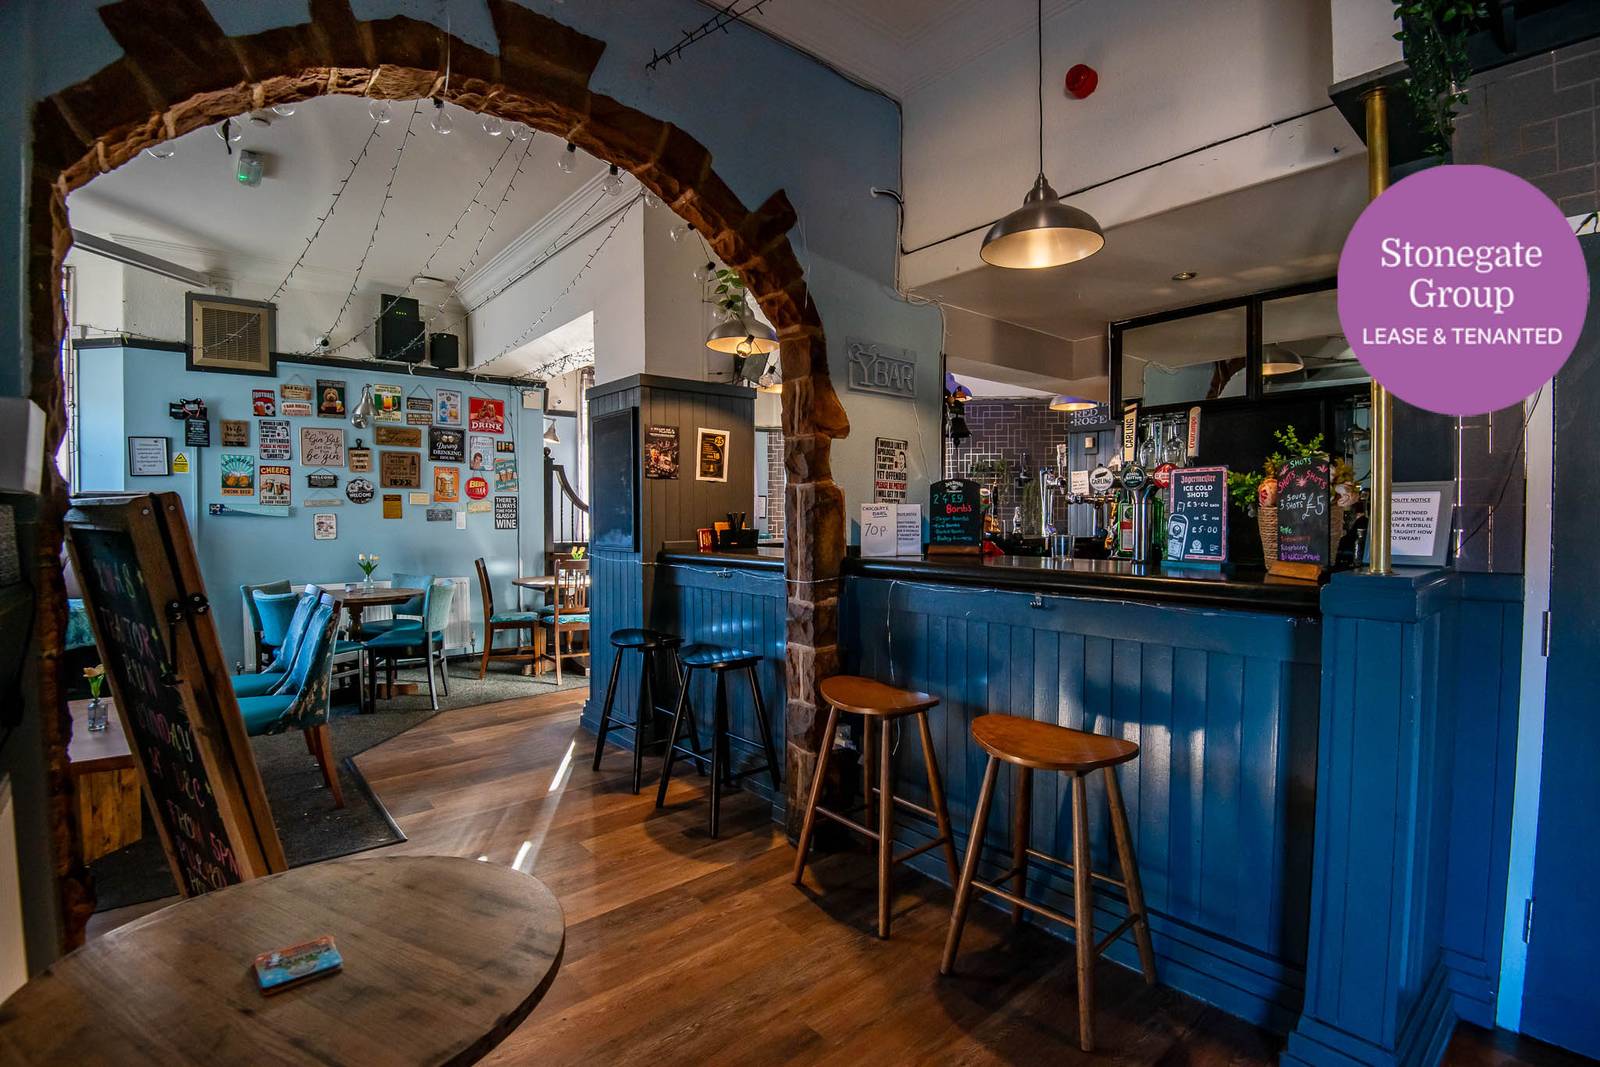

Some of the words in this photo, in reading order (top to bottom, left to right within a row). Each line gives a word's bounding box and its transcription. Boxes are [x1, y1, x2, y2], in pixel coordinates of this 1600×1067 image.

[1074, 409, 1098, 418] RED
[472, 421, 502, 431] DRINK
[1126, 418, 1134, 449] CARLING
[436, 442, 458, 450] During
[307, 448, 320, 461] be
[322, 454, 340, 464] gin
[1290, 458, 1312, 468] SHOTS
[877, 470, 886, 479] YET
[886, 472, 906, 480] OFFENDED
[1278, 470, 1296, 493] SHOTS
[1306, 471, 1327, 490] SHOTS
[946, 504, 972, 514] Bombs
[1302, 493, 1324, 520] £5
[496, 520, 516, 528] WINE
